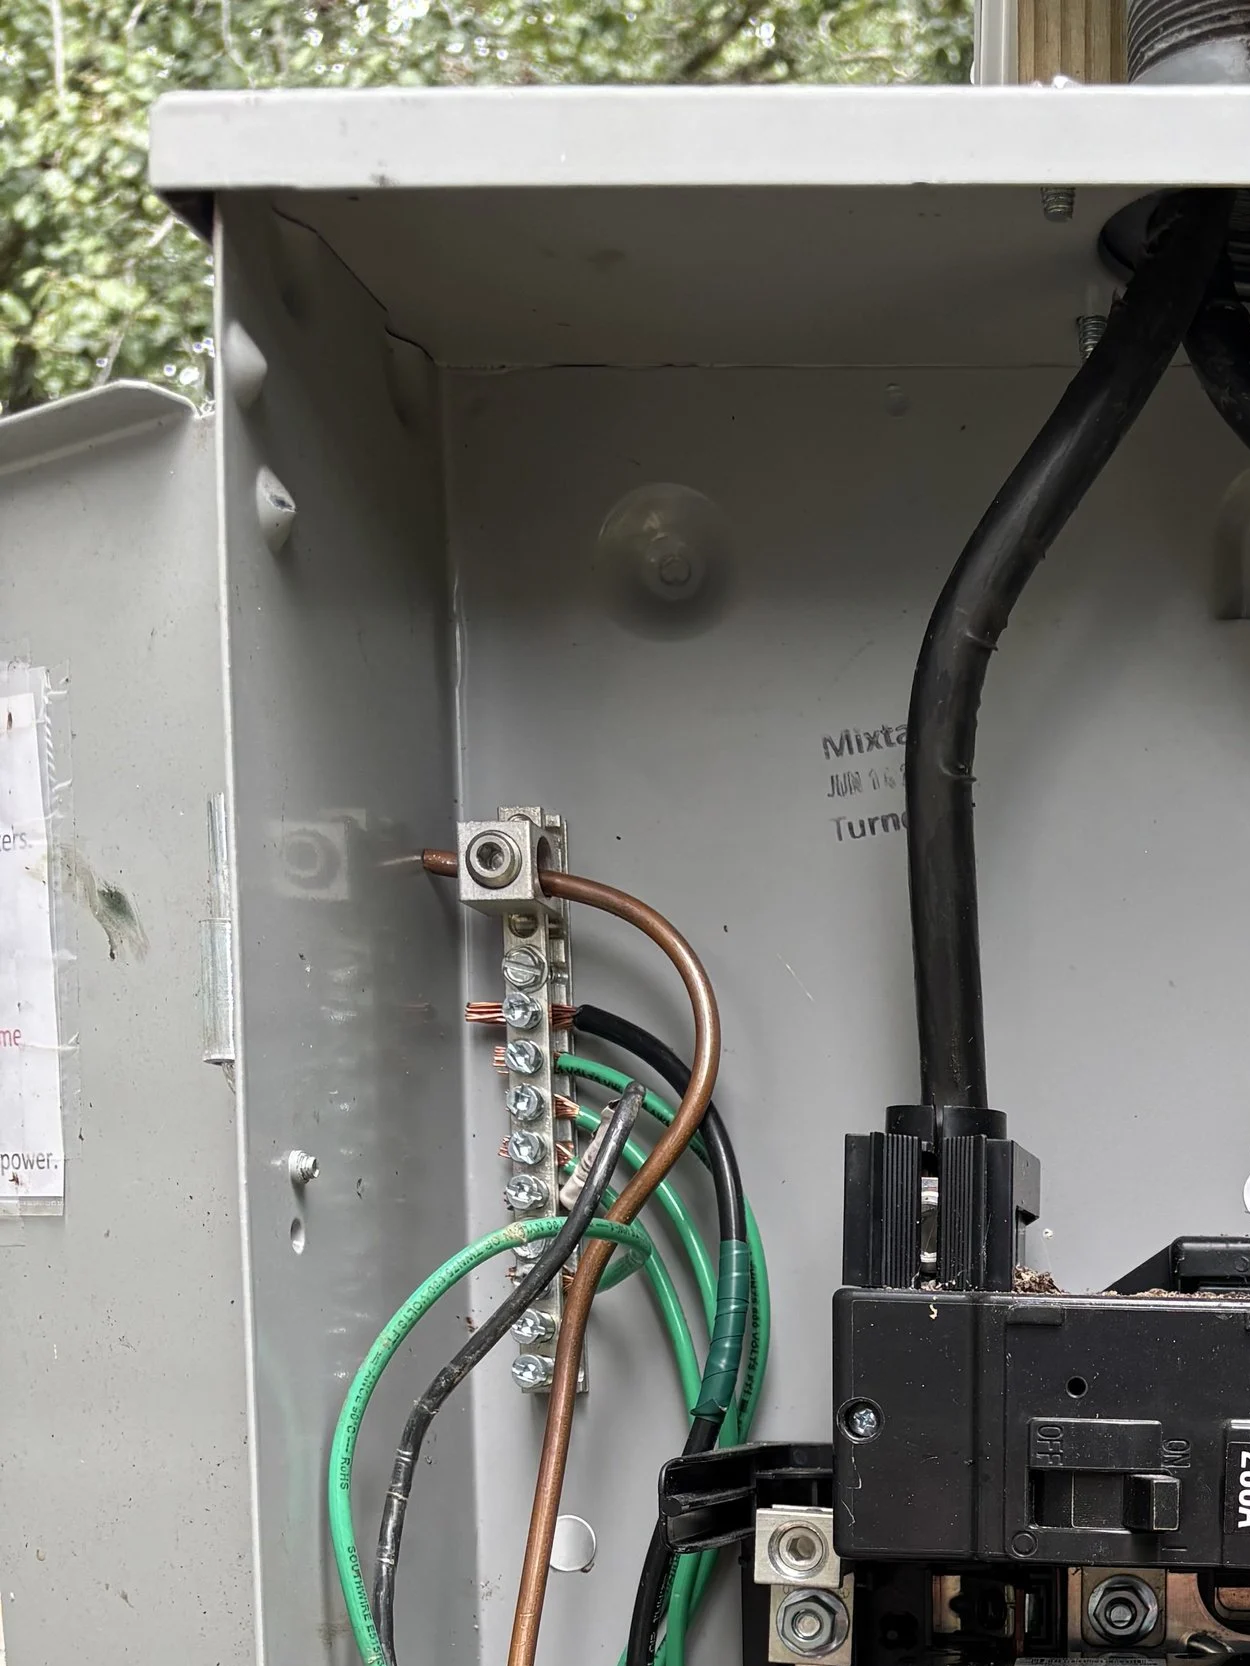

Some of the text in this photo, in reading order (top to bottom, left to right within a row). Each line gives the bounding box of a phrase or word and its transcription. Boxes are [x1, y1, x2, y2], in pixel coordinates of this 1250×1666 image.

[1, 1152, 58, 1172] power.
[1037, 1425, 1064, 1466] OFF
[1161, 1440, 1191, 1468] ON
